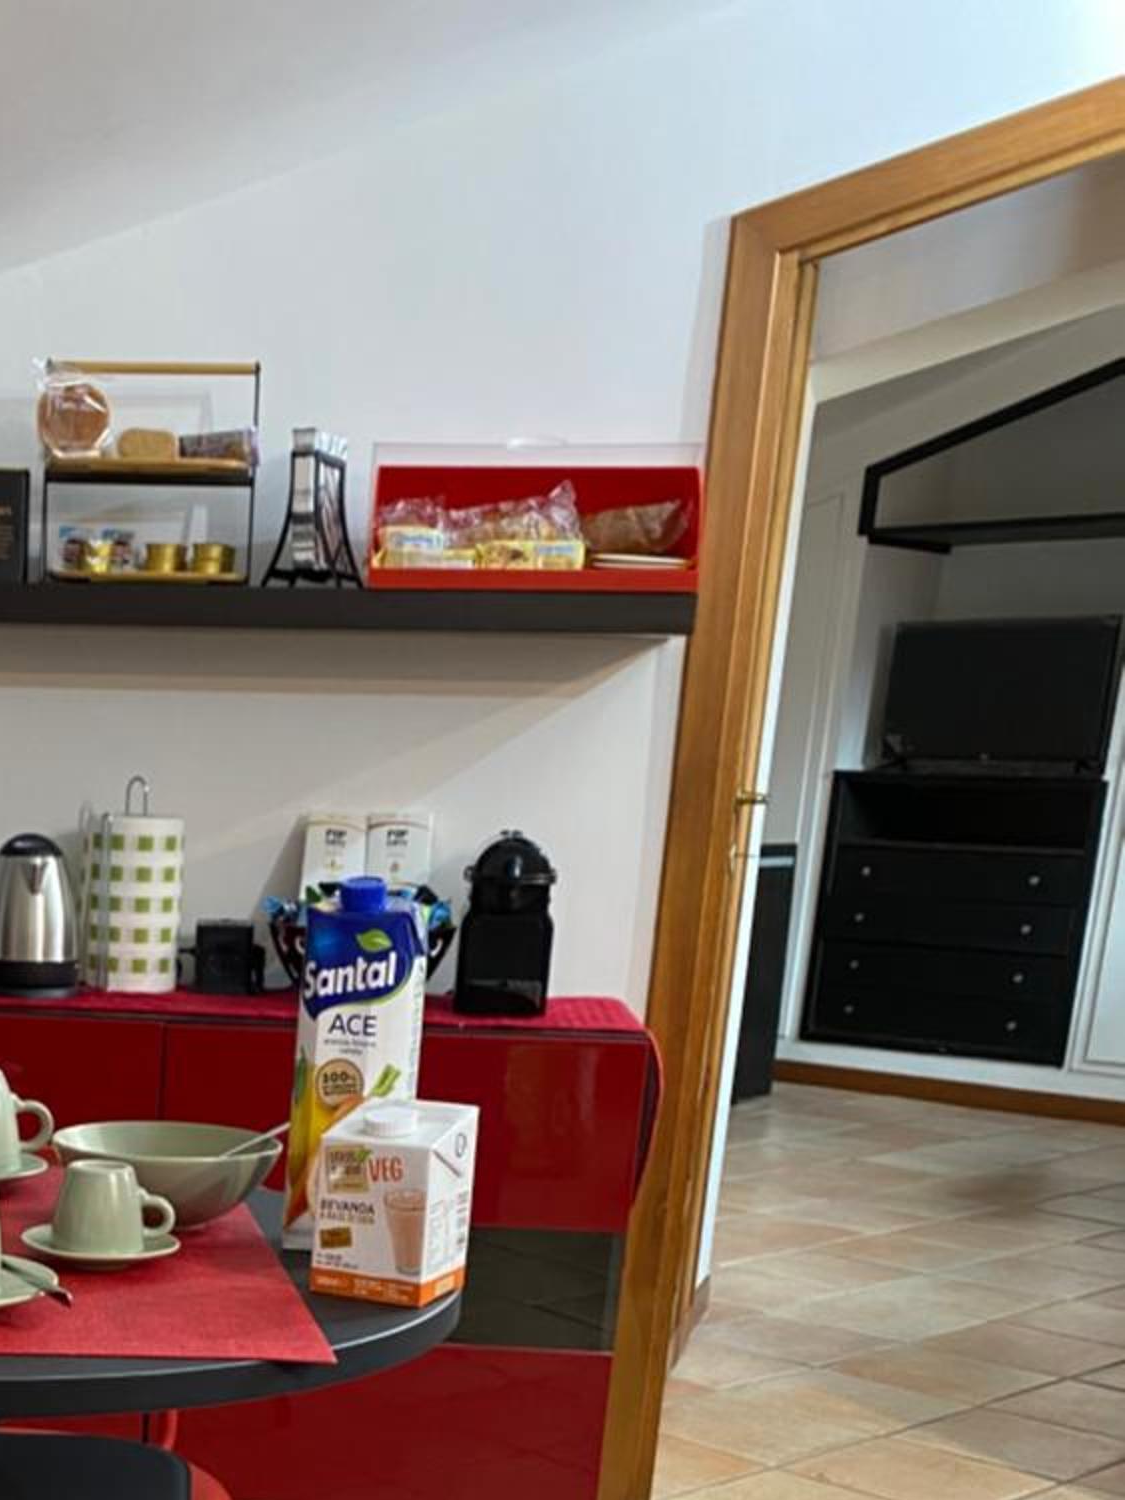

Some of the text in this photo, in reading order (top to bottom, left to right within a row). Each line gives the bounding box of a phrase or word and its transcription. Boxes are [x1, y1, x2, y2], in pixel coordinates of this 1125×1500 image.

[304, 951, 397, 999] Santal
[328, 1013, 378, 1037] ACE
[368, 1155, 404, 1183] VEG
